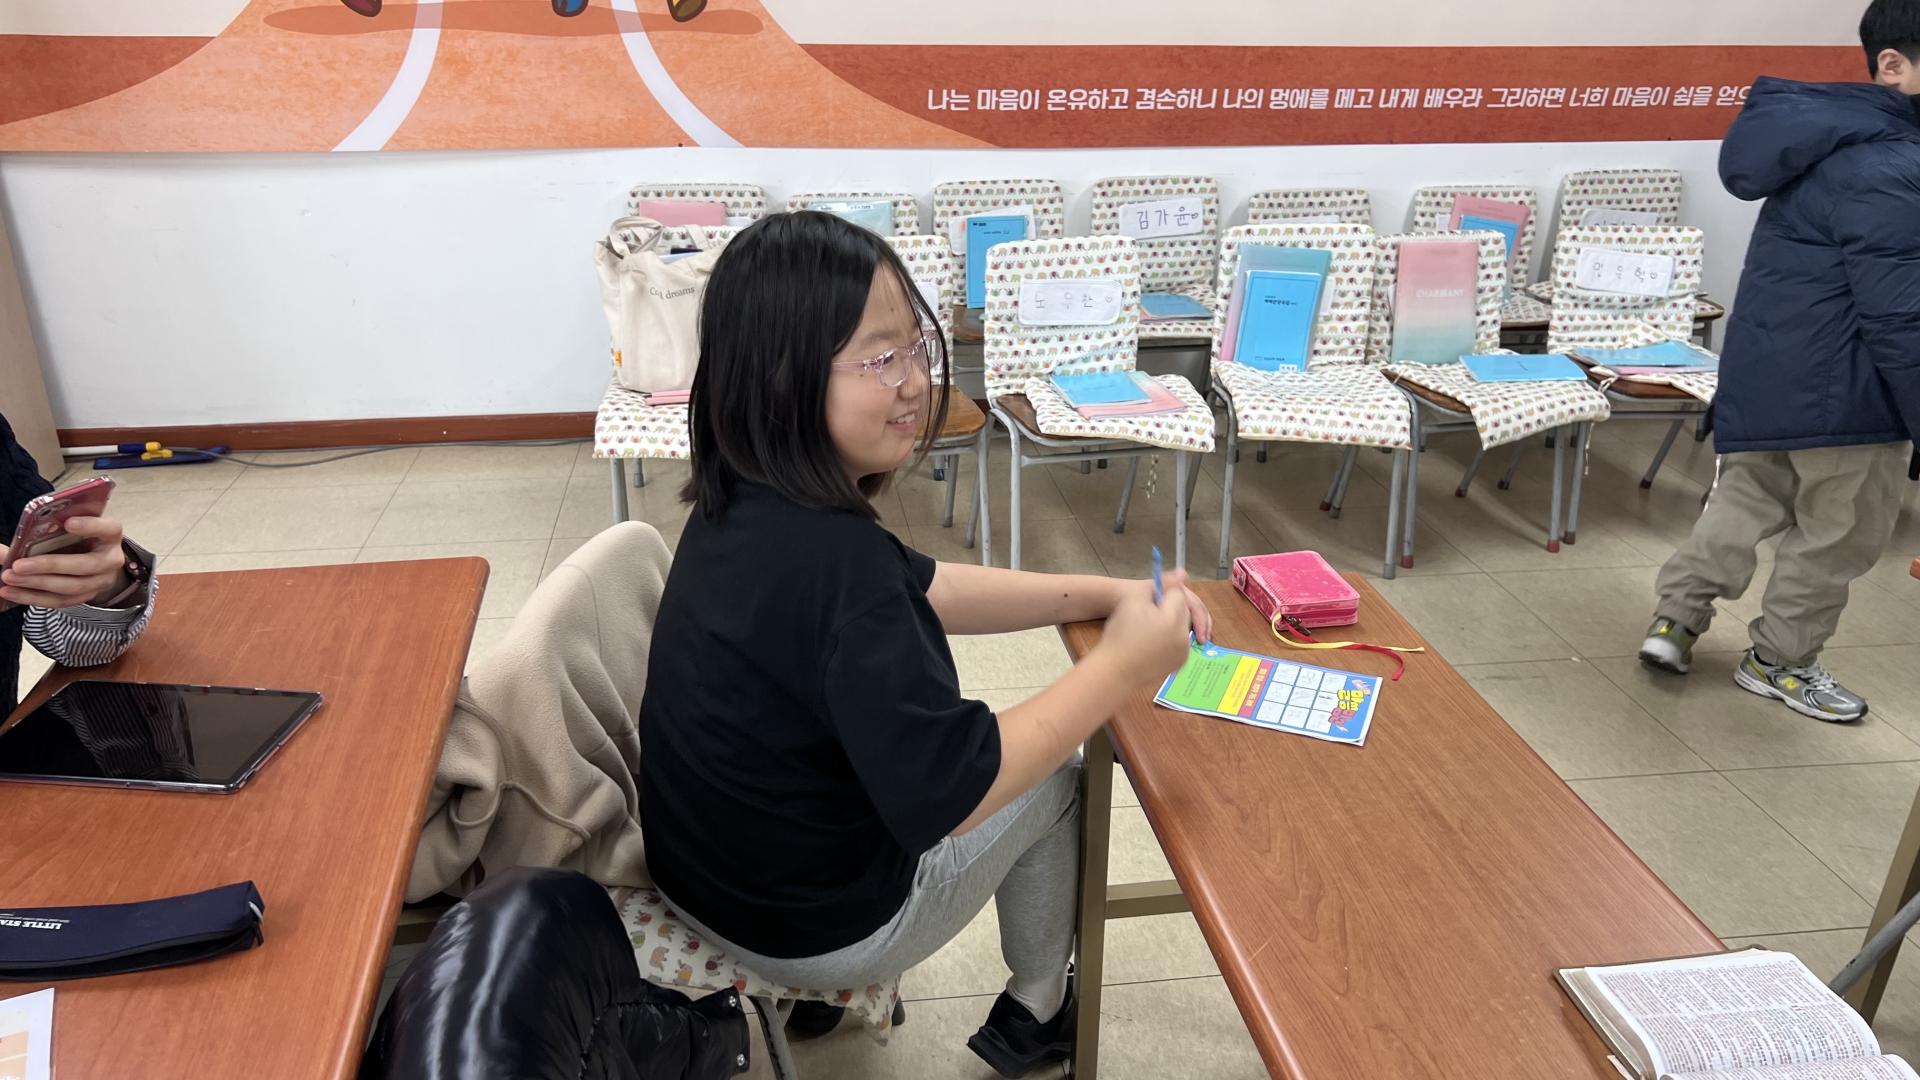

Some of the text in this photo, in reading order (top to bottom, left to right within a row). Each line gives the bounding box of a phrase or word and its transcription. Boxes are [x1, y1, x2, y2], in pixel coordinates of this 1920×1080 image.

[927, 88, 971, 111] 나는
[976, 88, 1040, 111] 마음이
[1046, 88, 1129, 111] 온유하고
[1135, 87, 1218, 110] 겸손하니
[1222, 88, 1265, 109] 나의
[1269, 88, 1330, 110] 멍에를
[1333, 88, 1375, 109] 메고
[1378, 88, 1420, 109] 내게
[1423, 87, 1483, 109] 배우라
[1486, 87, 1567, 108] 그리하면
[1568, 86, 1610, 107] 너희
[1612, 86, 1671, 107] 마음이
[1672, 86, 1713, 107] 쉼을
[665, 286, 696, 300] dreams
[22, 921, 62, 930] LITTLE
